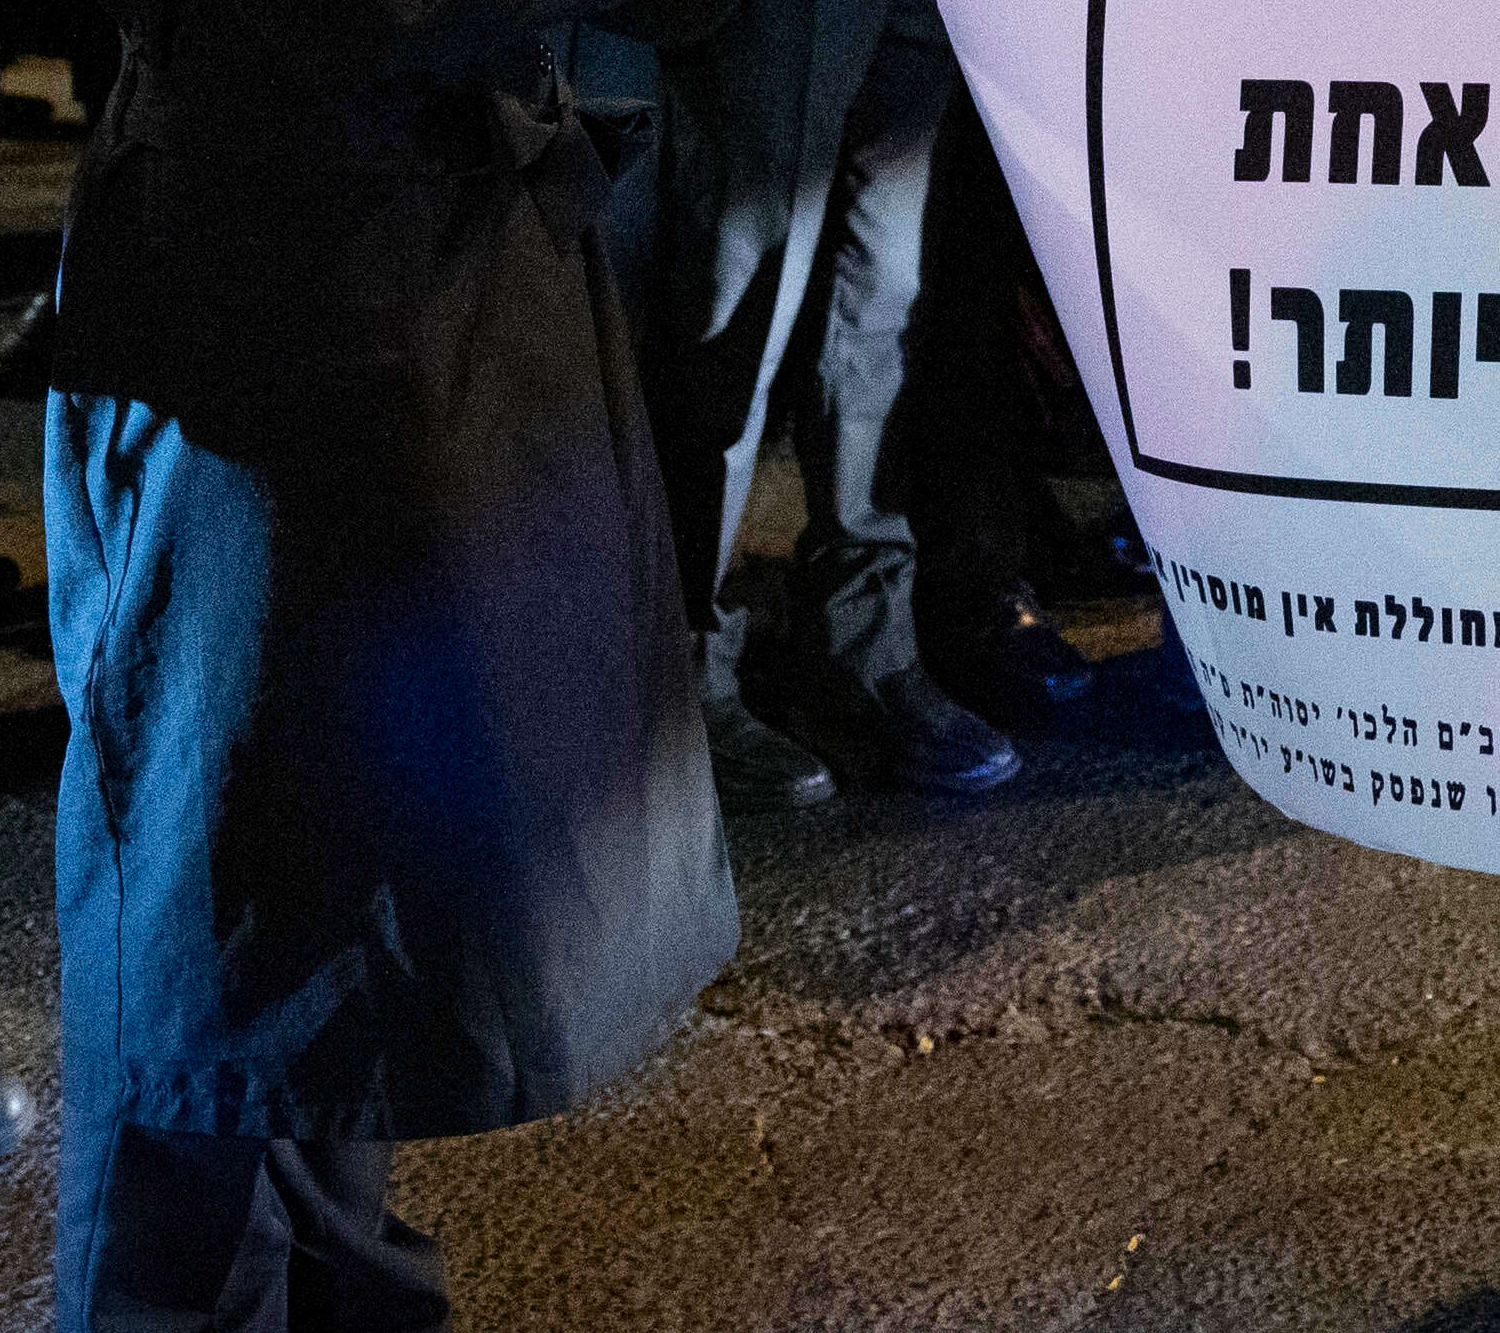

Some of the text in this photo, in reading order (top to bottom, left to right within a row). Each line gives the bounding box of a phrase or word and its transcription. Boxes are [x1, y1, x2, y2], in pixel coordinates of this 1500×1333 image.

[1234, 80, 1490, 187] אחת
[1170, 562, 1266, 623] מוסרין
[1282, 592, 1336, 636] אין
[1280, 746, 1354, 792] בשו"ע
[1371, 771, 1465, 810] שנפסק
